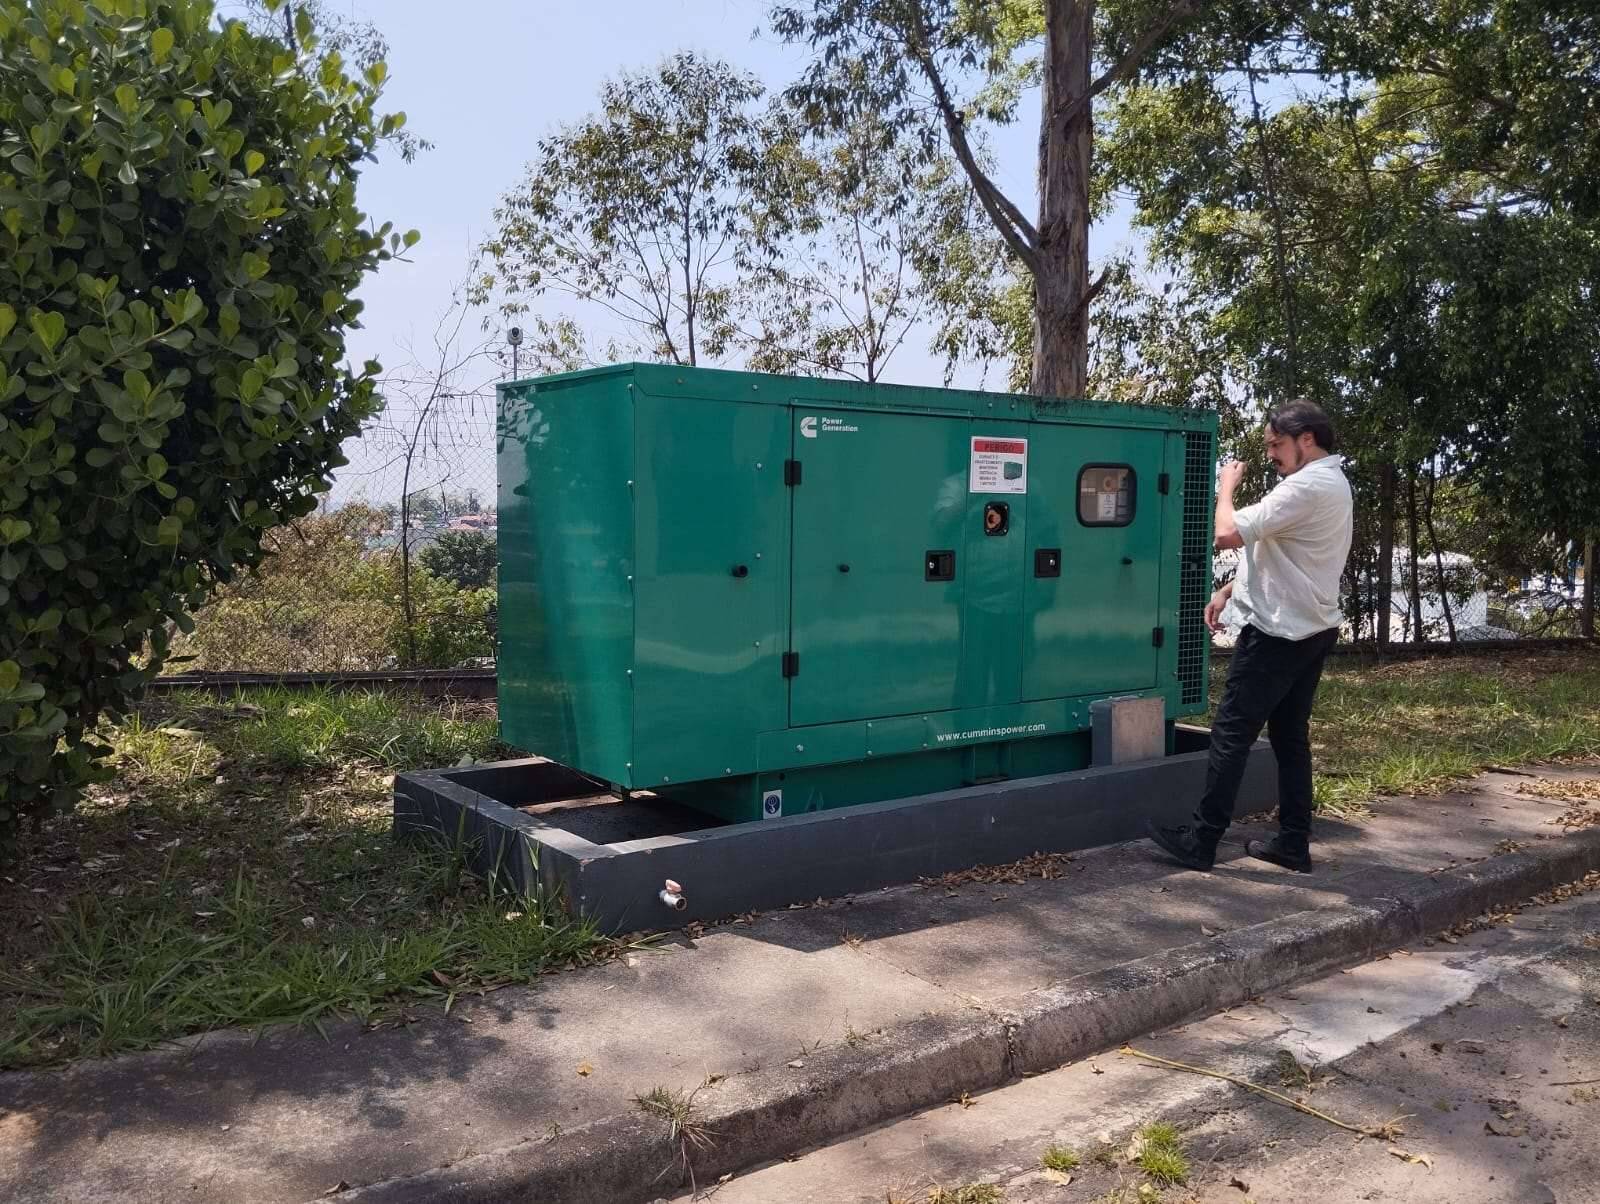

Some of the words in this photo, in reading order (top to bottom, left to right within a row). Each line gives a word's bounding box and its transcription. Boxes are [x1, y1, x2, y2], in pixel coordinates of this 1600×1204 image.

[821, 416, 843, 425] Power
[821, 424, 859, 432] Generation
[984, 442, 1015, 454] PERIGO
[936, 723, 1046, 742] www.cumminspower.com
